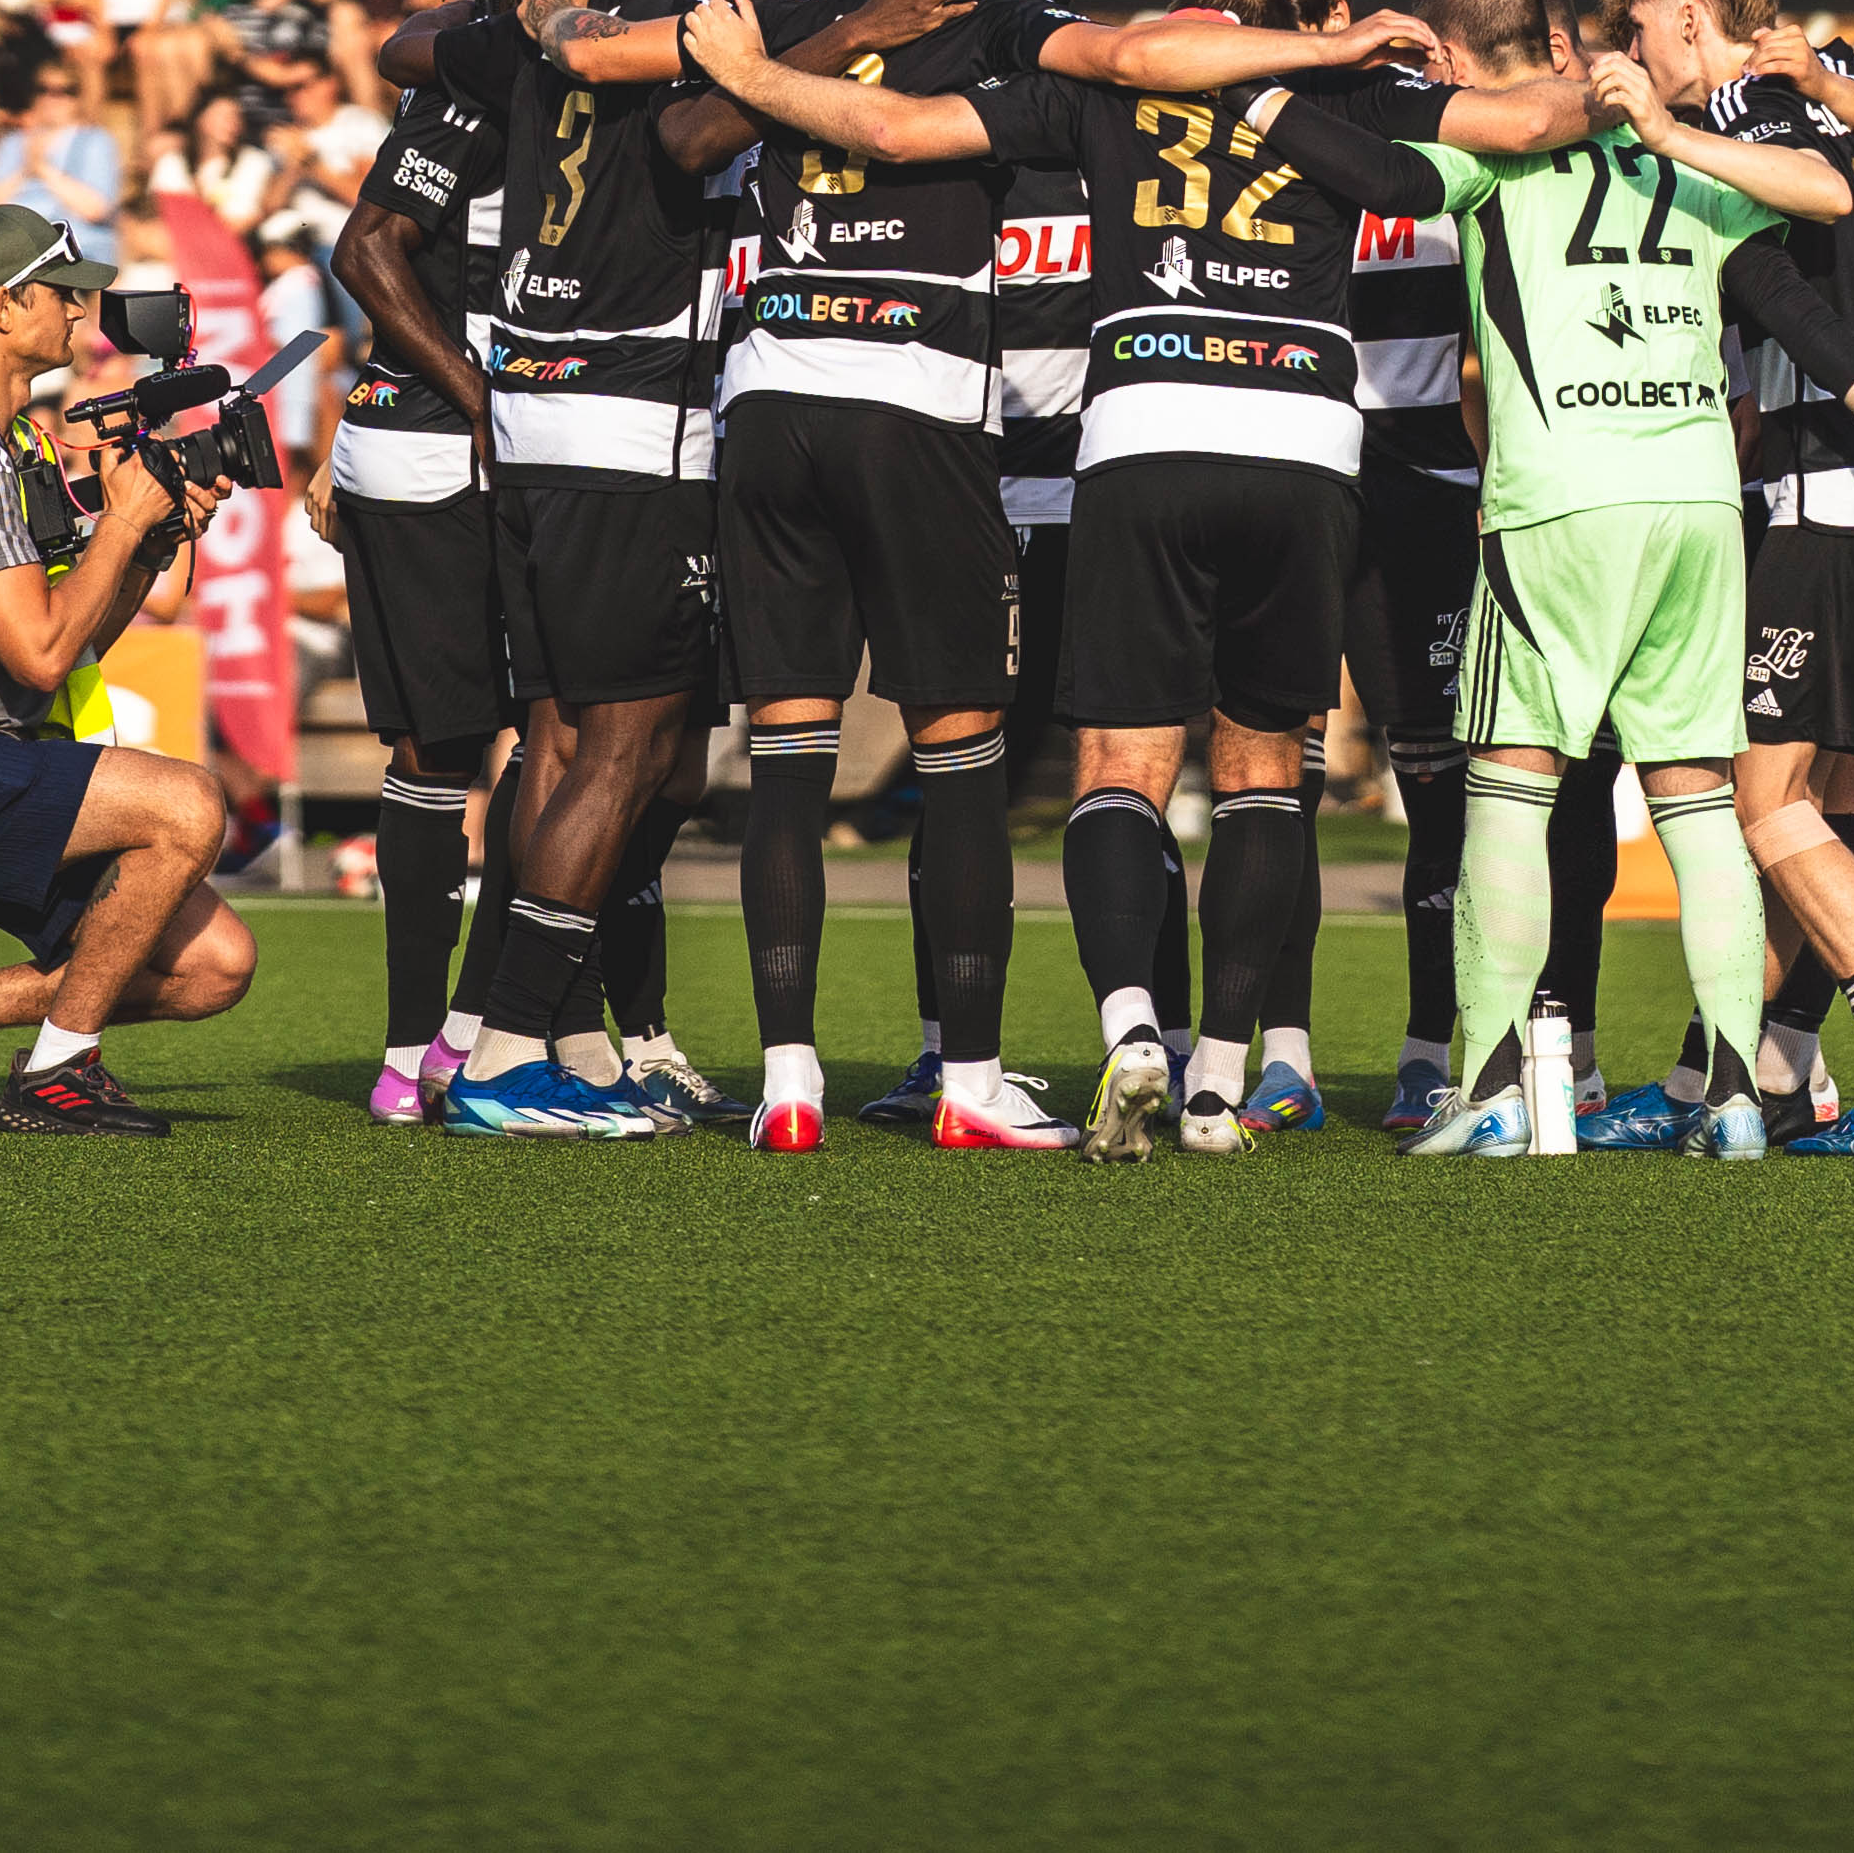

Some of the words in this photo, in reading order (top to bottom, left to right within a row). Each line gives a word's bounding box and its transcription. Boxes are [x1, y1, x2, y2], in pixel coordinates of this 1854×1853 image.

[400, 147, 458, 190] Seven
[1133, 98, 1302, 245] 32
[1549, 140, 1694, 267] 22
[829, 219, 906, 243] ELPEC
[526, 274, 581, 300] ELPEC
[1205, 260, 1291, 290] ELPEC
[755, 293, 872, 324] COOLBET
[1643, 304, 1703, 327] ELPEC
[490, 344, 555, 382] OLBET
[1113, 333, 1269, 366] COOLBET
[151, 366, 214, 384] COMICA
[1555, 380, 1692, 409] COOLBET
[1437, 613, 1453, 625] FIT
[1761, 626, 1780, 640] FIT
[1431, 653, 1452, 665] 24H
[1748, 627, 1815, 679] Life
[1746, 667, 1769, 681] 24H
[1746, 703, 1783, 717] adidas
